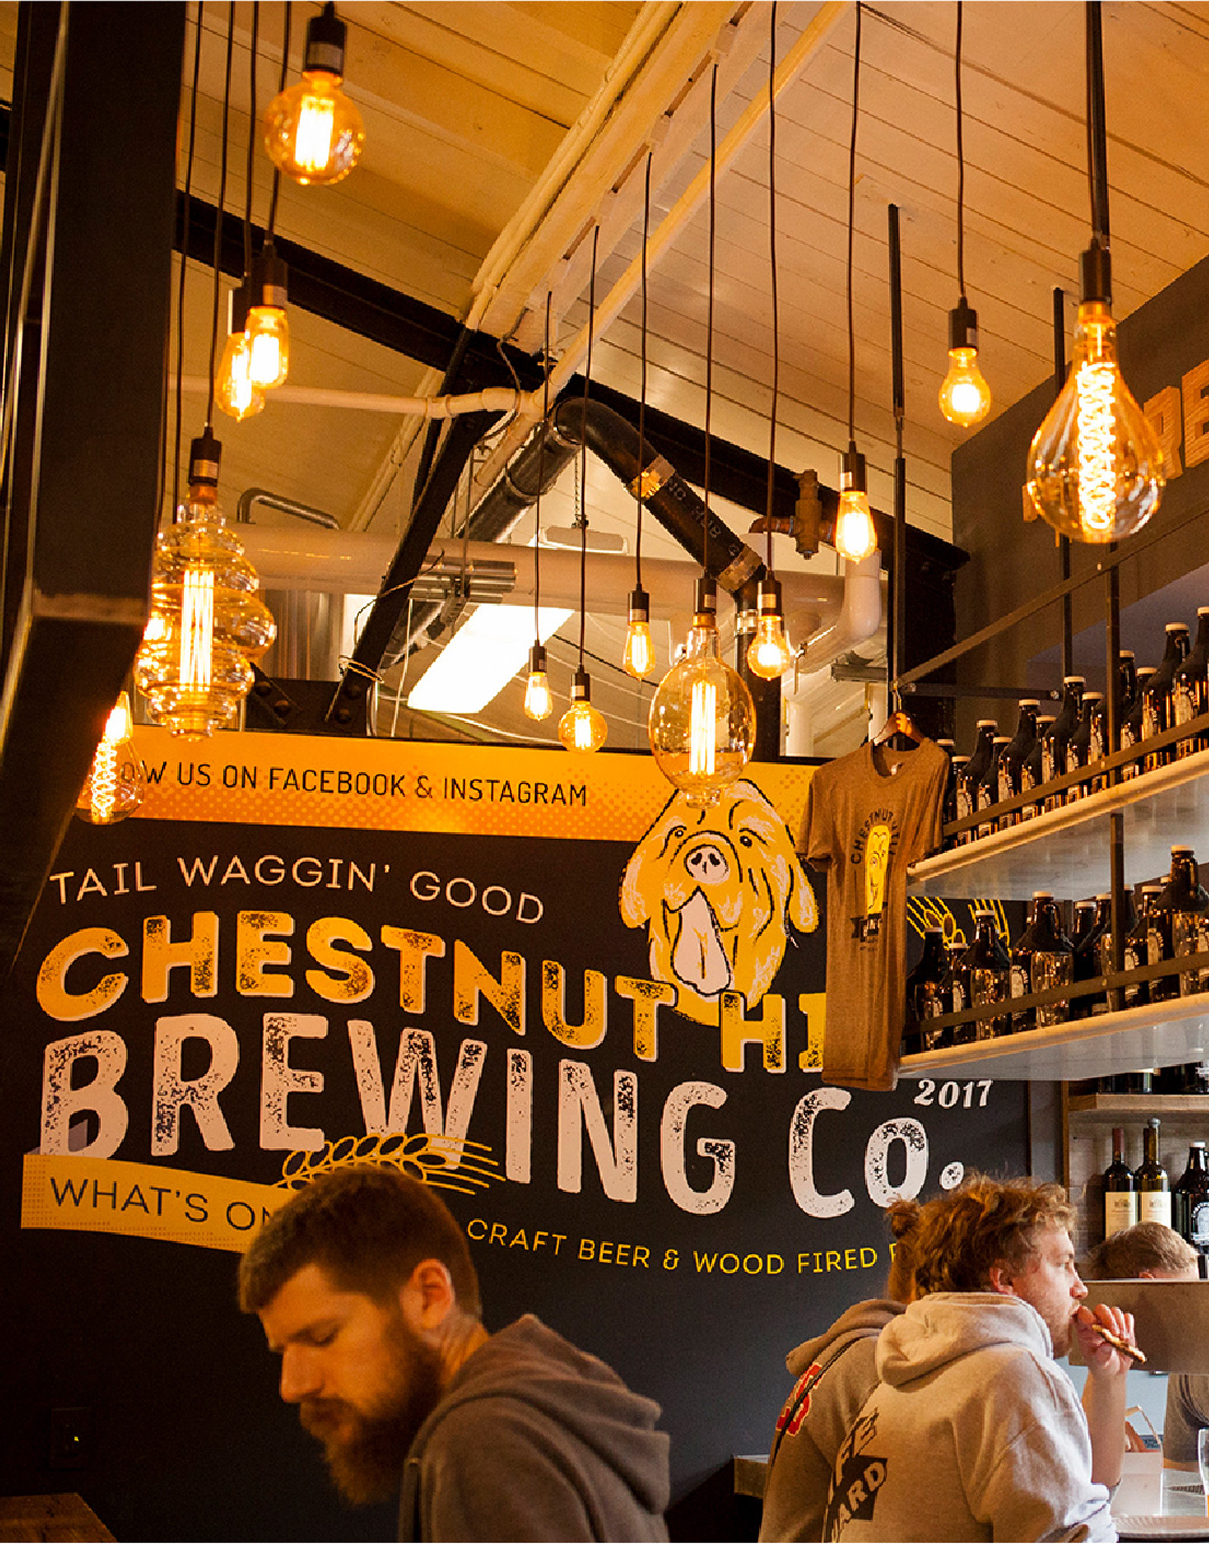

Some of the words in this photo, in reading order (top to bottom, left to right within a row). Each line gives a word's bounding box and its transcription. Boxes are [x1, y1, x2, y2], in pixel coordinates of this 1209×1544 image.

[177, 762, 211, 787] US
[222, 764, 257, 789] ON
[269, 767, 405, 799] FACEBOOK
[415, 776, 433, 799] &
[443, 780, 588, 807] INSTAGRAM
[50, 861, 157, 905] TAIL
[176, 856, 391, 892] WAGGIN'
[409, 870, 544, 924] GOOD
[36, 910, 678, 1062] CHESTNUT
[40, 1013, 735, 1215] BREWING
[788, 1088, 965, 1219] Co.
[914, 1078, 994, 1109] 2017
[50, 1177, 209, 1225] WHAT'S
[466, 1218, 568, 1256] CRAFT
[577, 1238, 650, 1269] BEER
[662, 1248, 680, 1271] &
[693, 1250, 785, 1275] WOOD
[796, 1245, 879, 1274] FIRED
